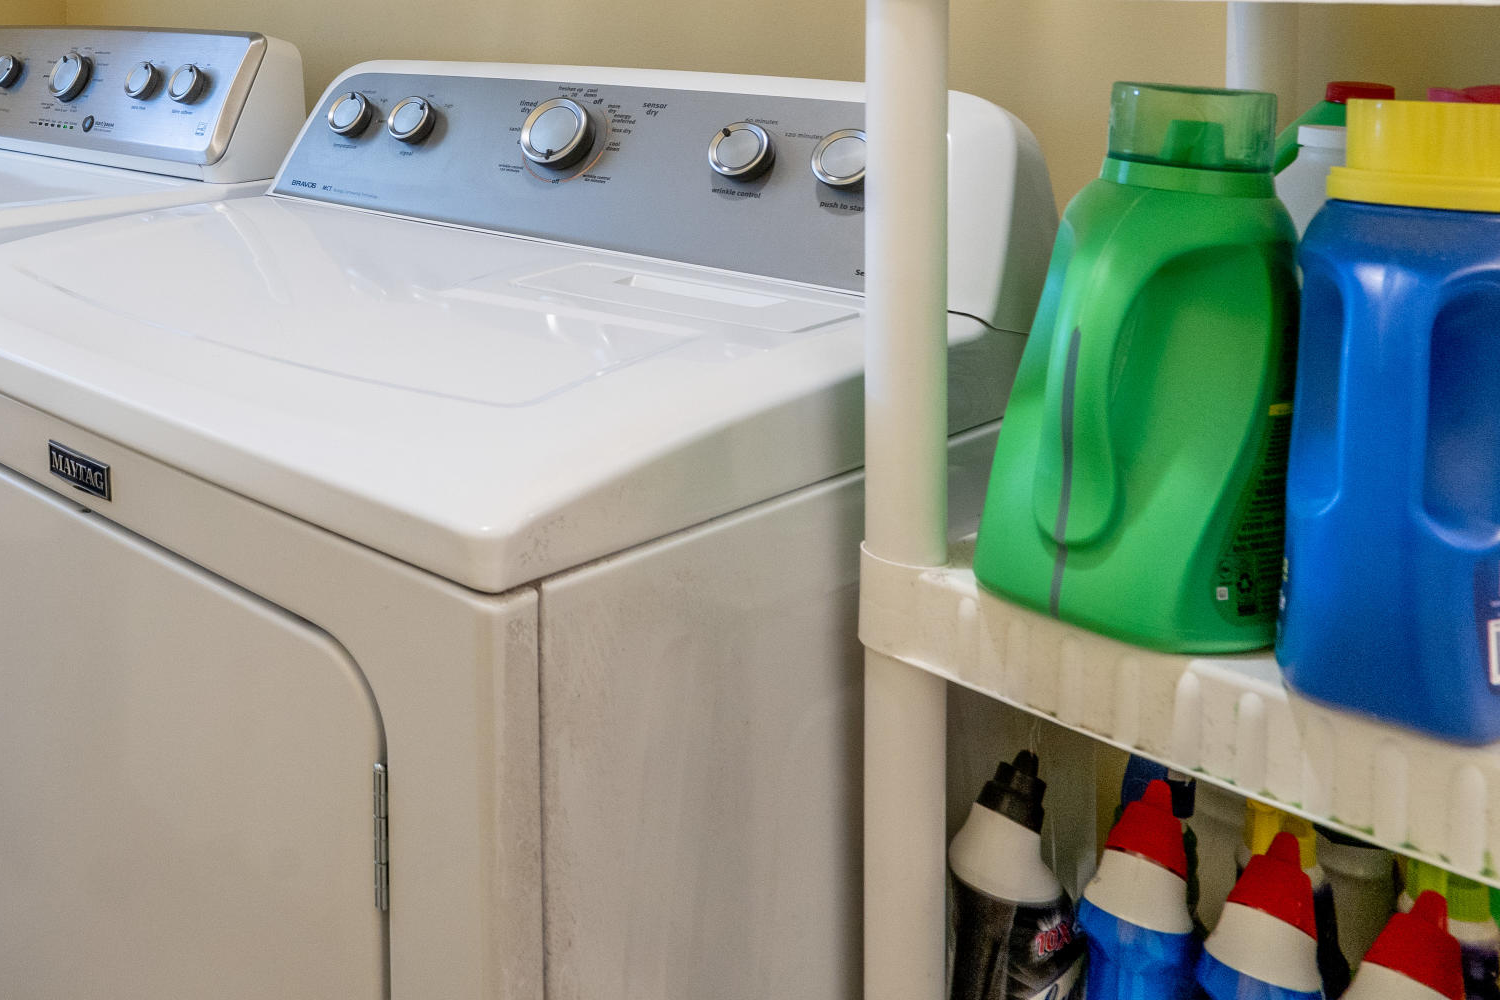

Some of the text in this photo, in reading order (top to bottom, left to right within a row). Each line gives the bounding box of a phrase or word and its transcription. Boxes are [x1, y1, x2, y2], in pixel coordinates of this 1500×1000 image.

[645, 108, 659, 117] dry
[291, 179, 317, 189] BRAVOS
[711, 187, 761, 199] wrinkle control
[819, 200, 839, 209] push
[840, 202, 848, 210] to
[51, 450, 104, 491] MAYTAG
